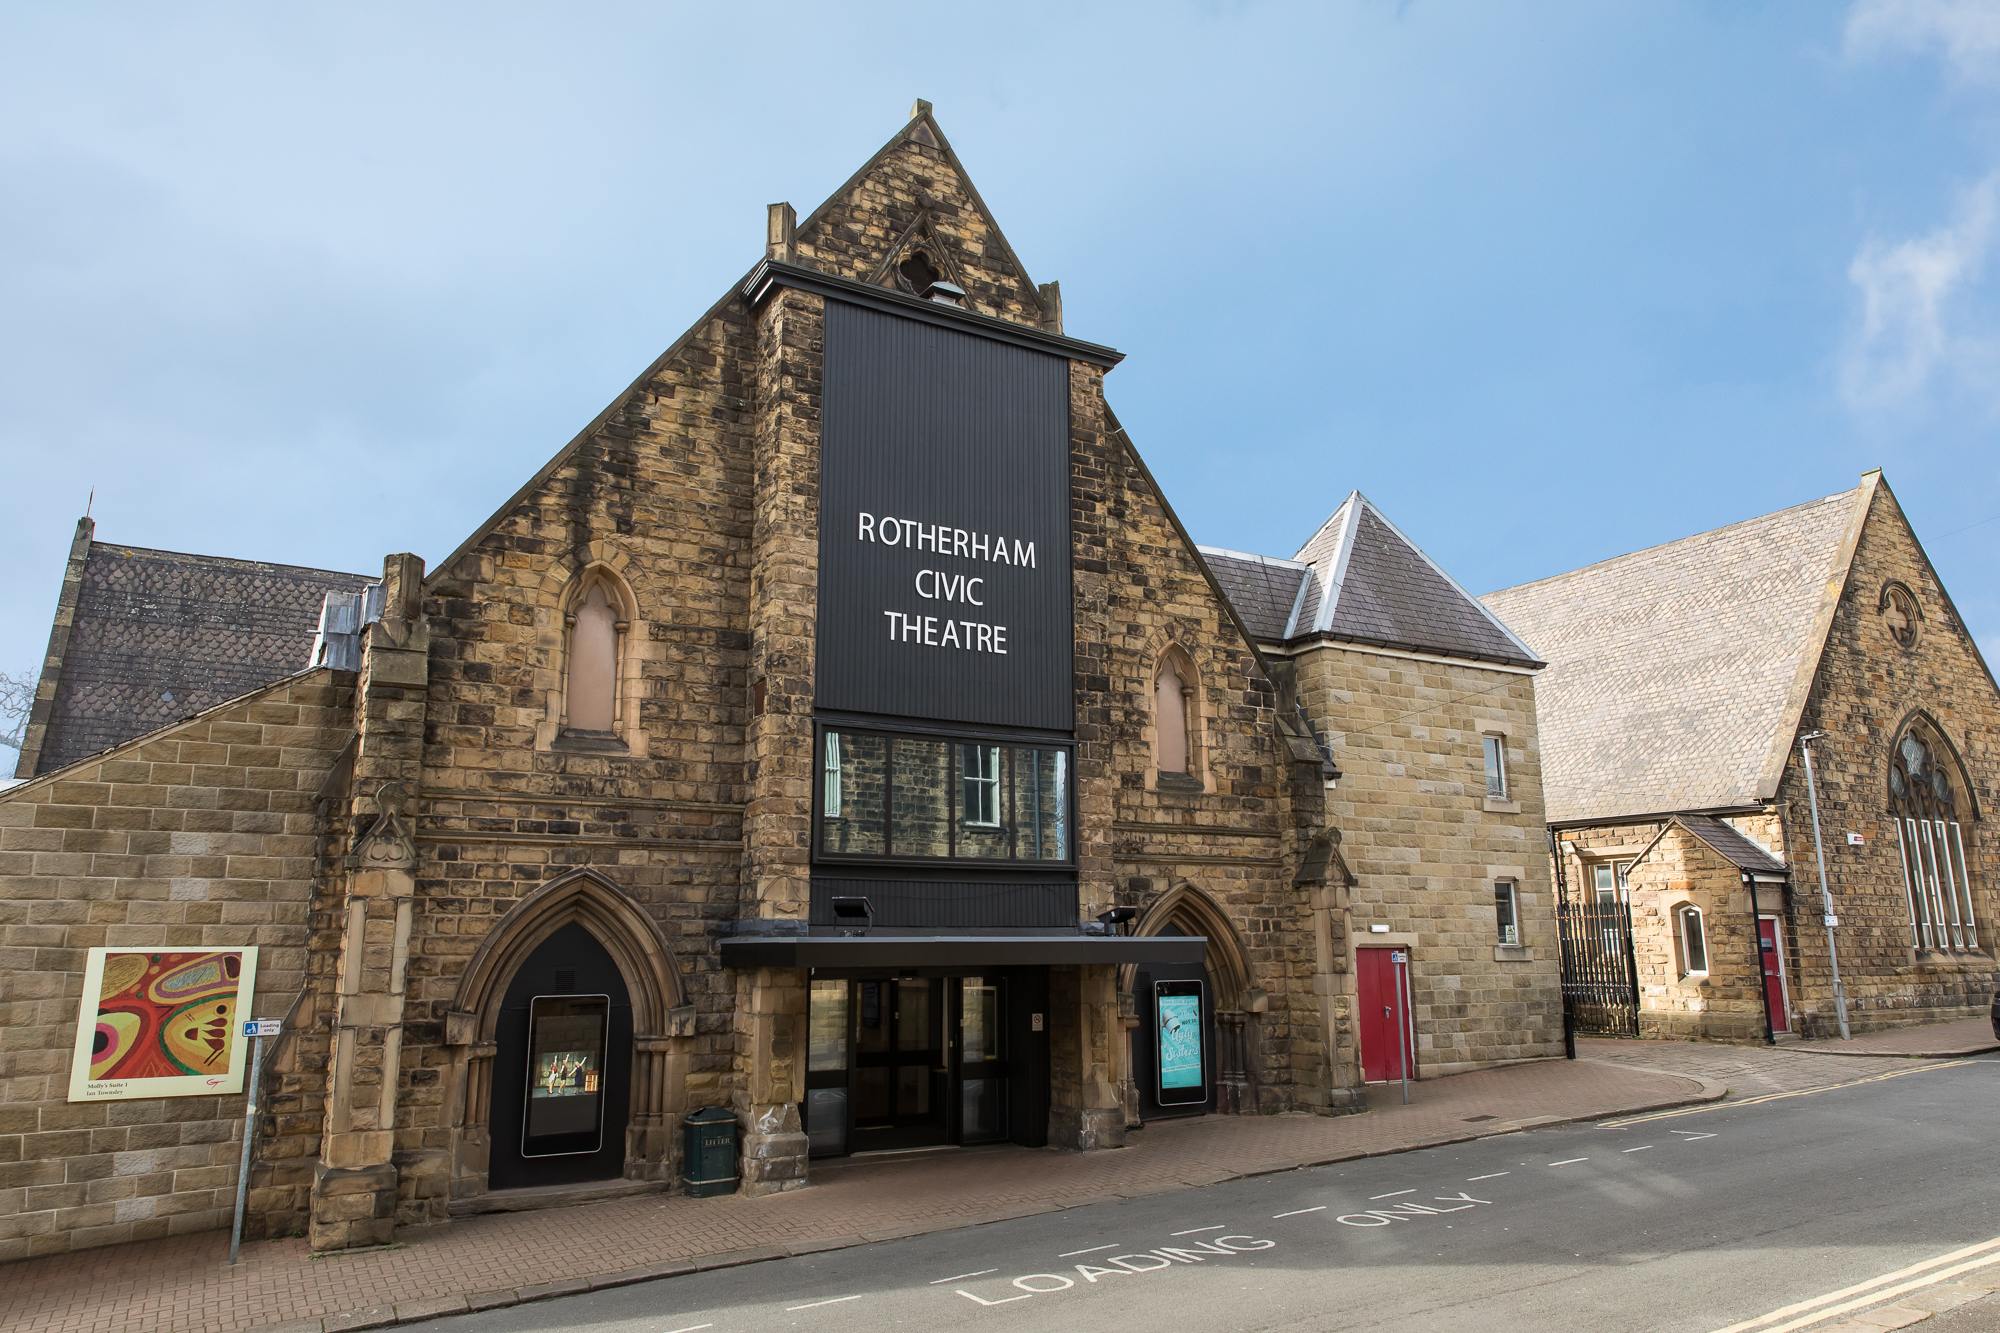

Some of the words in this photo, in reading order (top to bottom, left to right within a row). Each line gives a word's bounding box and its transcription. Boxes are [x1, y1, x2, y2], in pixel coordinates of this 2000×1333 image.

[858, 512, 1036, 569] ROTHERHAM
[915, 569, 984, 606] CIVIC
[884, 610, 1007, 655] THEATRE
[1166, 1044, 1199, 1062] Sisters
[1172, 1028, 1195, 1044] Ugly
[705, 1138, 731, 1146] LITTER
[955, 1235, 1276, 1306] LOADING
[1336, 1192, 1493, 1227] ONLY
